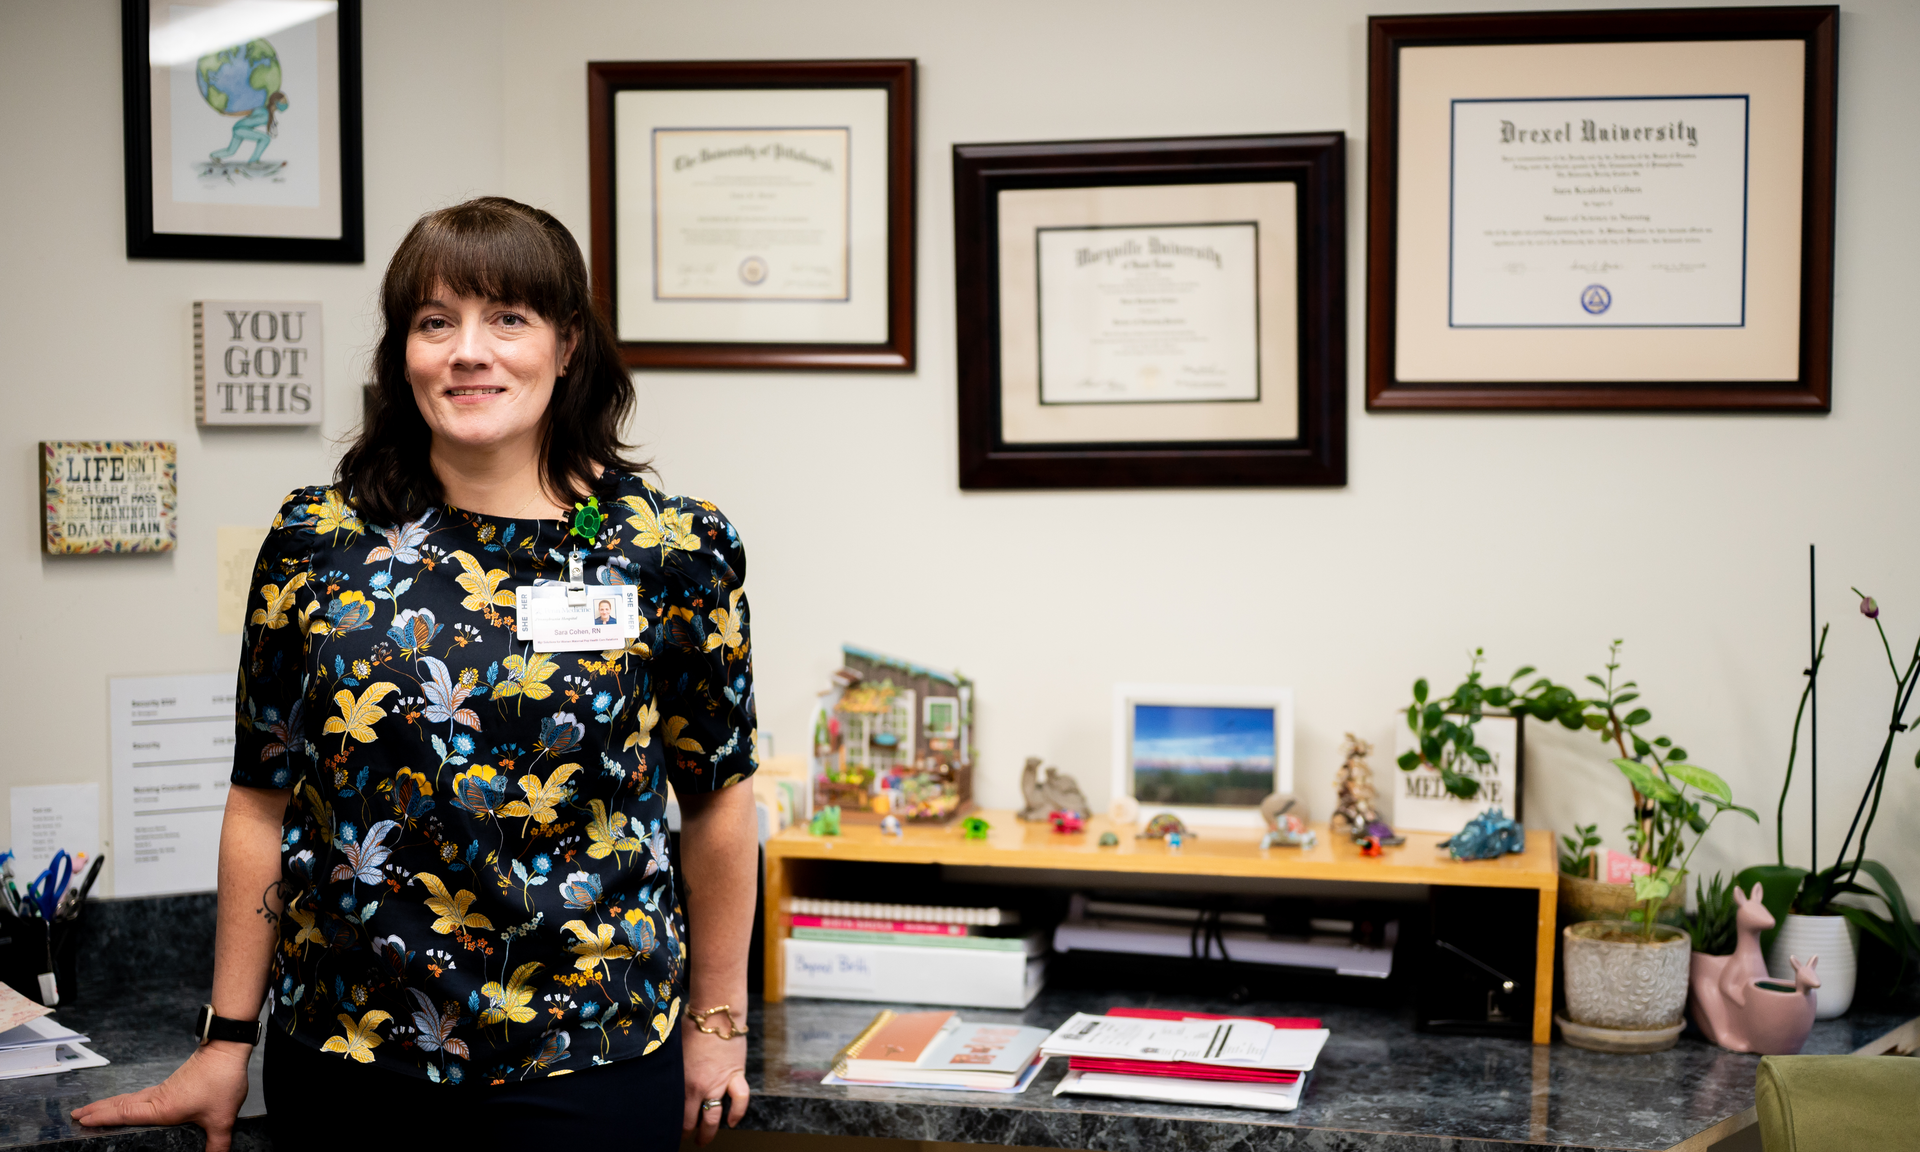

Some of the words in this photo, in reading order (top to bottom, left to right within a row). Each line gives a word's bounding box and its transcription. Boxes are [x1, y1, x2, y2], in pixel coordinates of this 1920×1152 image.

[1499, 119, 1571, 144] Drexel
[1580, 119, 1699, 147] University
[699, 144, 757, 163] University
[224, 310, 307, 343] YOU
[224, 346, 308, 379] GOT
[217, 382, 312, 414] THIS
[66, 456, 124, 482] LIFE
[127, 454, 159, 473] ISN'T
[66, 481, 128, 495] waiting
[131, 494, 157, 505] PASS
[90, 505, 144, 521] LEARNING
[130, 522, 160, 534] RAIN
[626, 592, 634, 608] SHE
[1405, 775, 1503, 803] MEDNE
